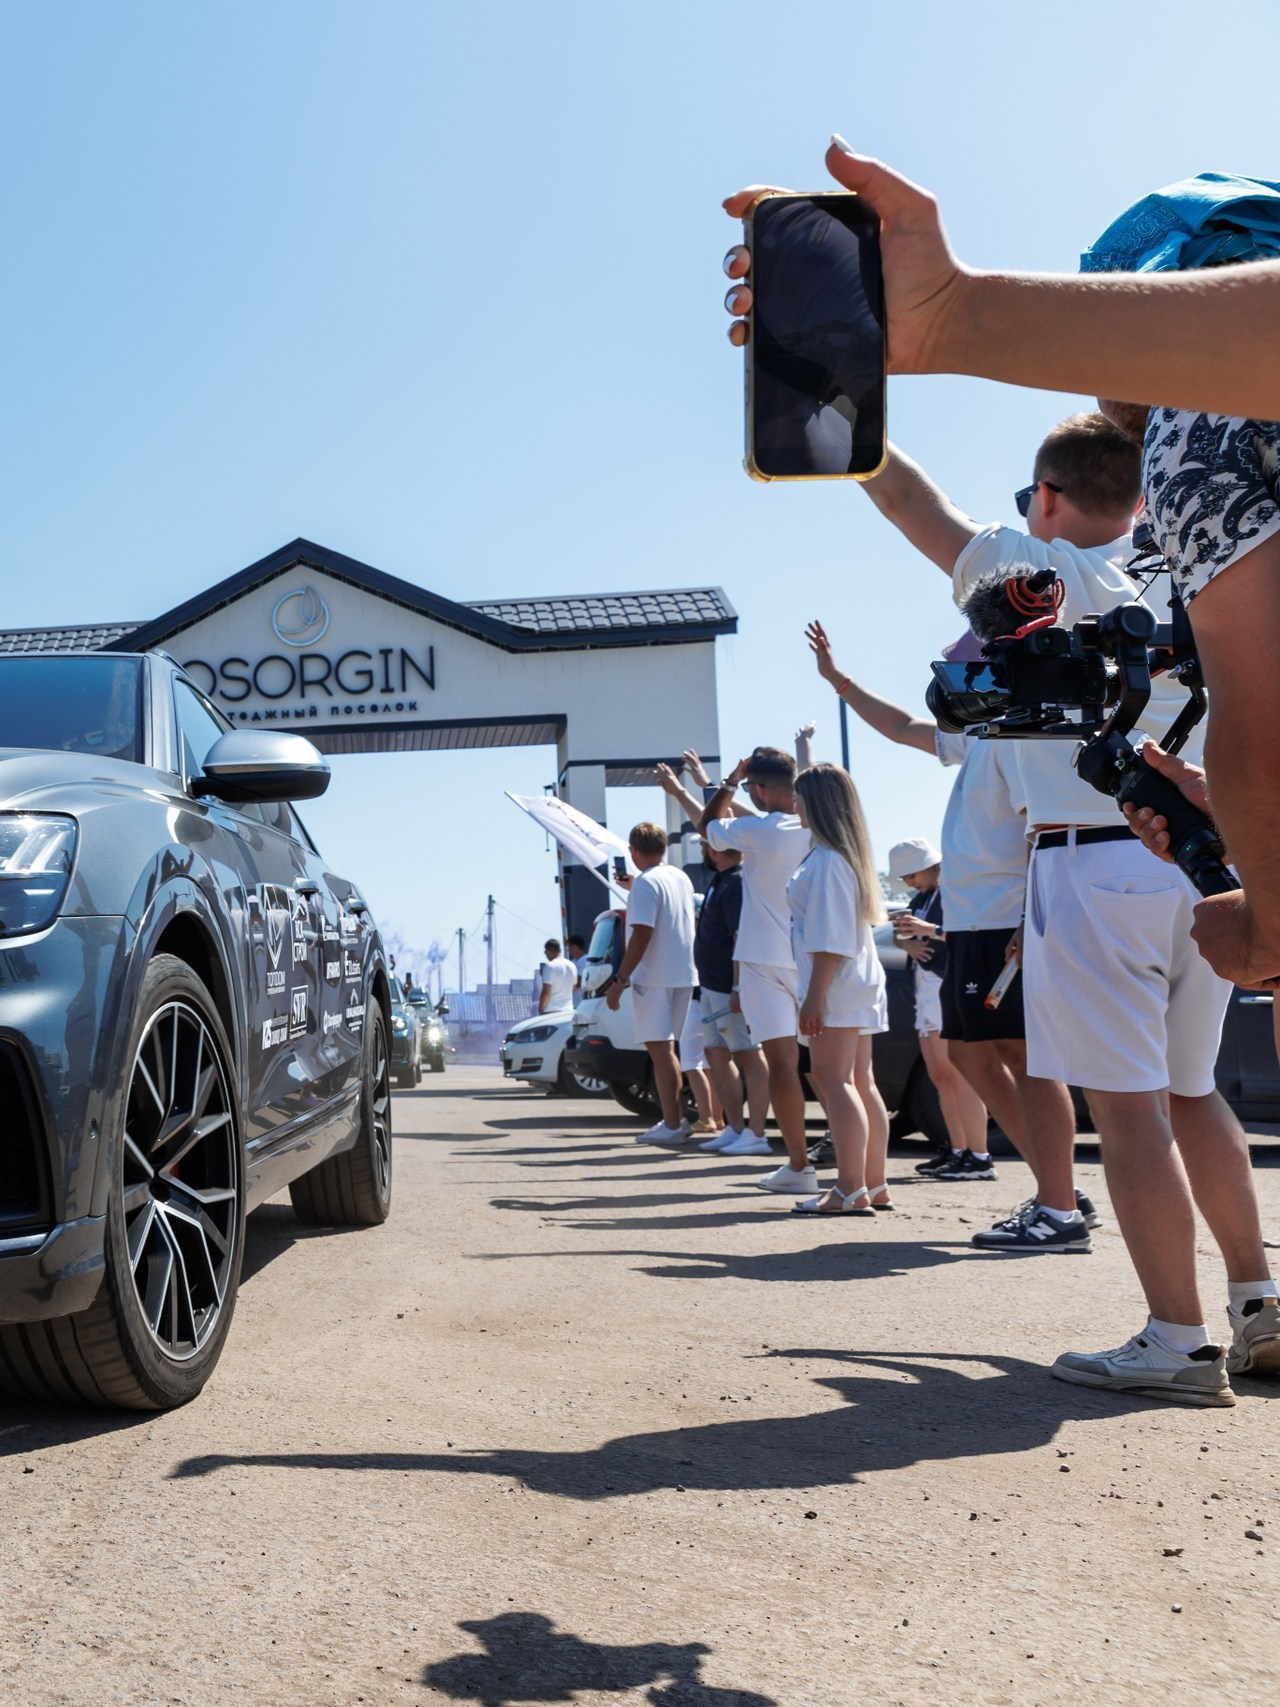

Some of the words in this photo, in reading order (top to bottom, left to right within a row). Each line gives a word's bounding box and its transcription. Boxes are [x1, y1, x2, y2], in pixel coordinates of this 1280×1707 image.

[182, 645, 436, 702] OSORGIN
[227, 705, 318, 721] теджный
[330, 701, 418, 716] поселок
